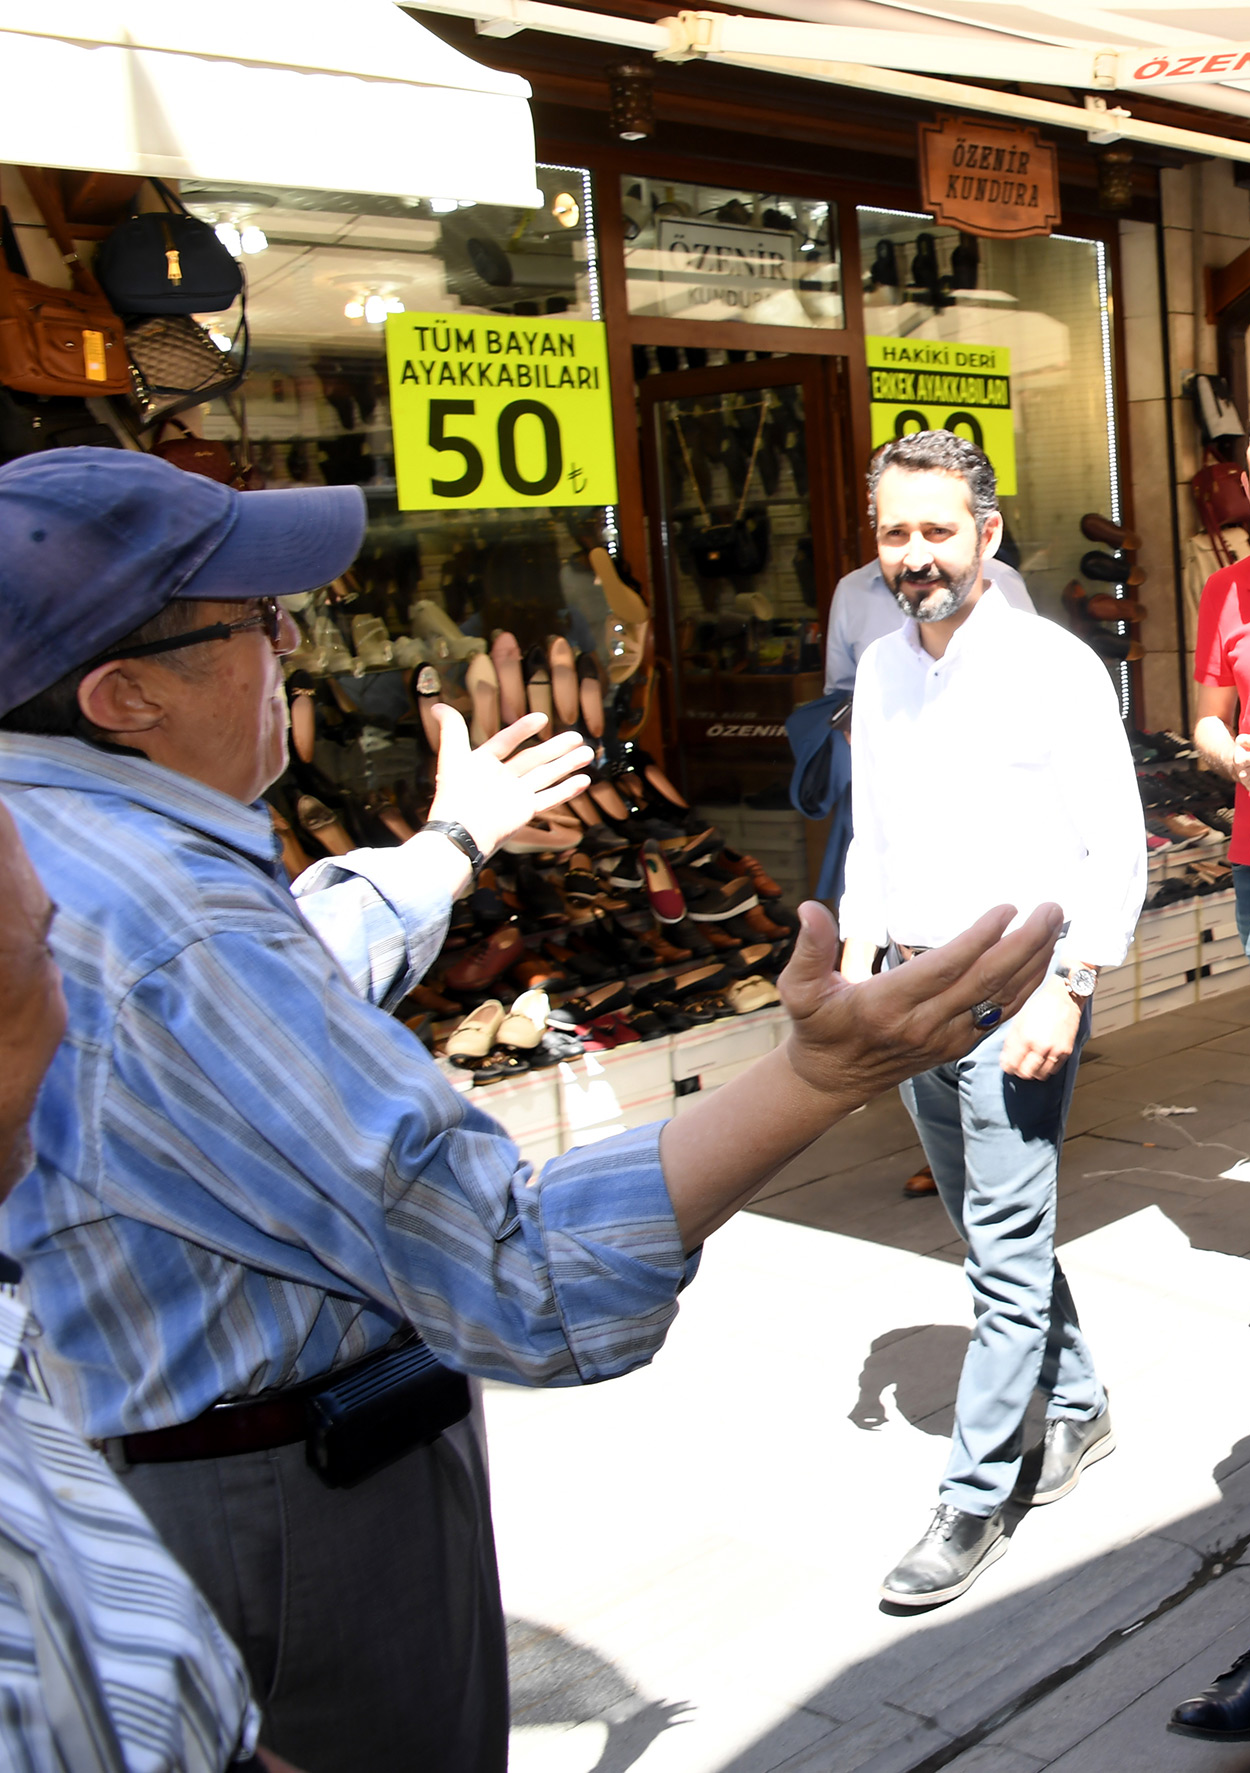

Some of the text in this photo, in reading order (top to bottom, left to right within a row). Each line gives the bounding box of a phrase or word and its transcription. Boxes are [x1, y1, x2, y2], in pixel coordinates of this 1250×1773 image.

[952, 137, 1030, 175] ÖZENİR
[945, 174, 1039, 208] KUNDURA
[669, 233, 787, 281] ÖZENİR
[414, 319, 575, 357] TÜM BAYAN
[882, 345, 995, 368] HAKİKİ DERİ
[401, 359, 599, 390] AYAKKABILARI
[872, 371, 1008, 405] ERKEK AYAKKABILARI
